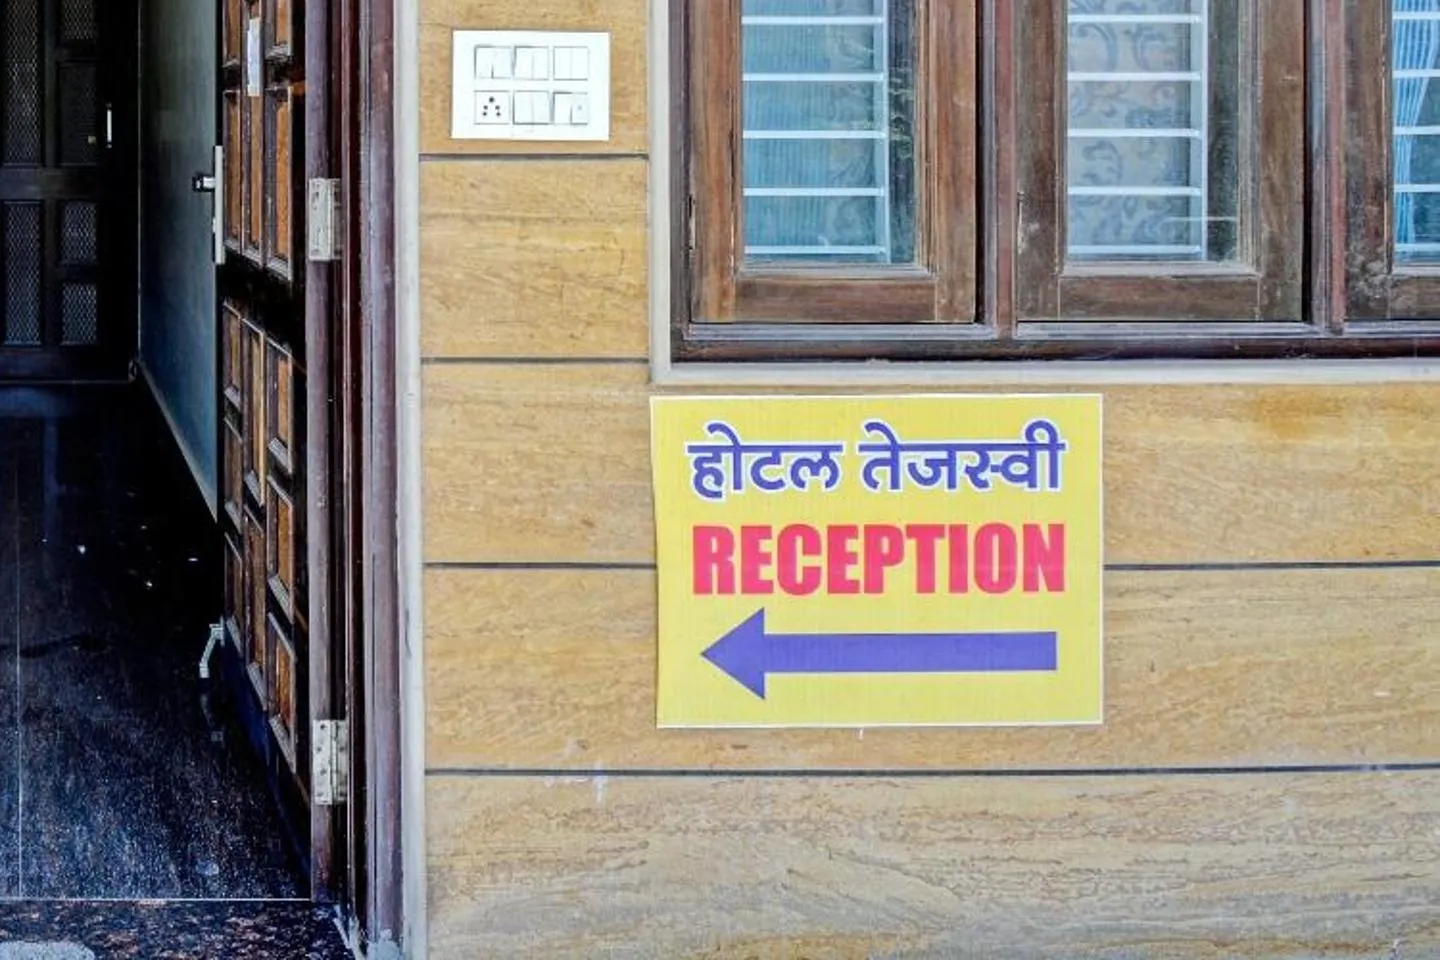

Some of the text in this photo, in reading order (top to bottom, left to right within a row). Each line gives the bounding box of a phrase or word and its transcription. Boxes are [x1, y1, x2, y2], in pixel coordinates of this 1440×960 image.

[686, 419, 1067, 498] होटल तेजस्वी
[692, 522, 1066, 595] RECEPTION
